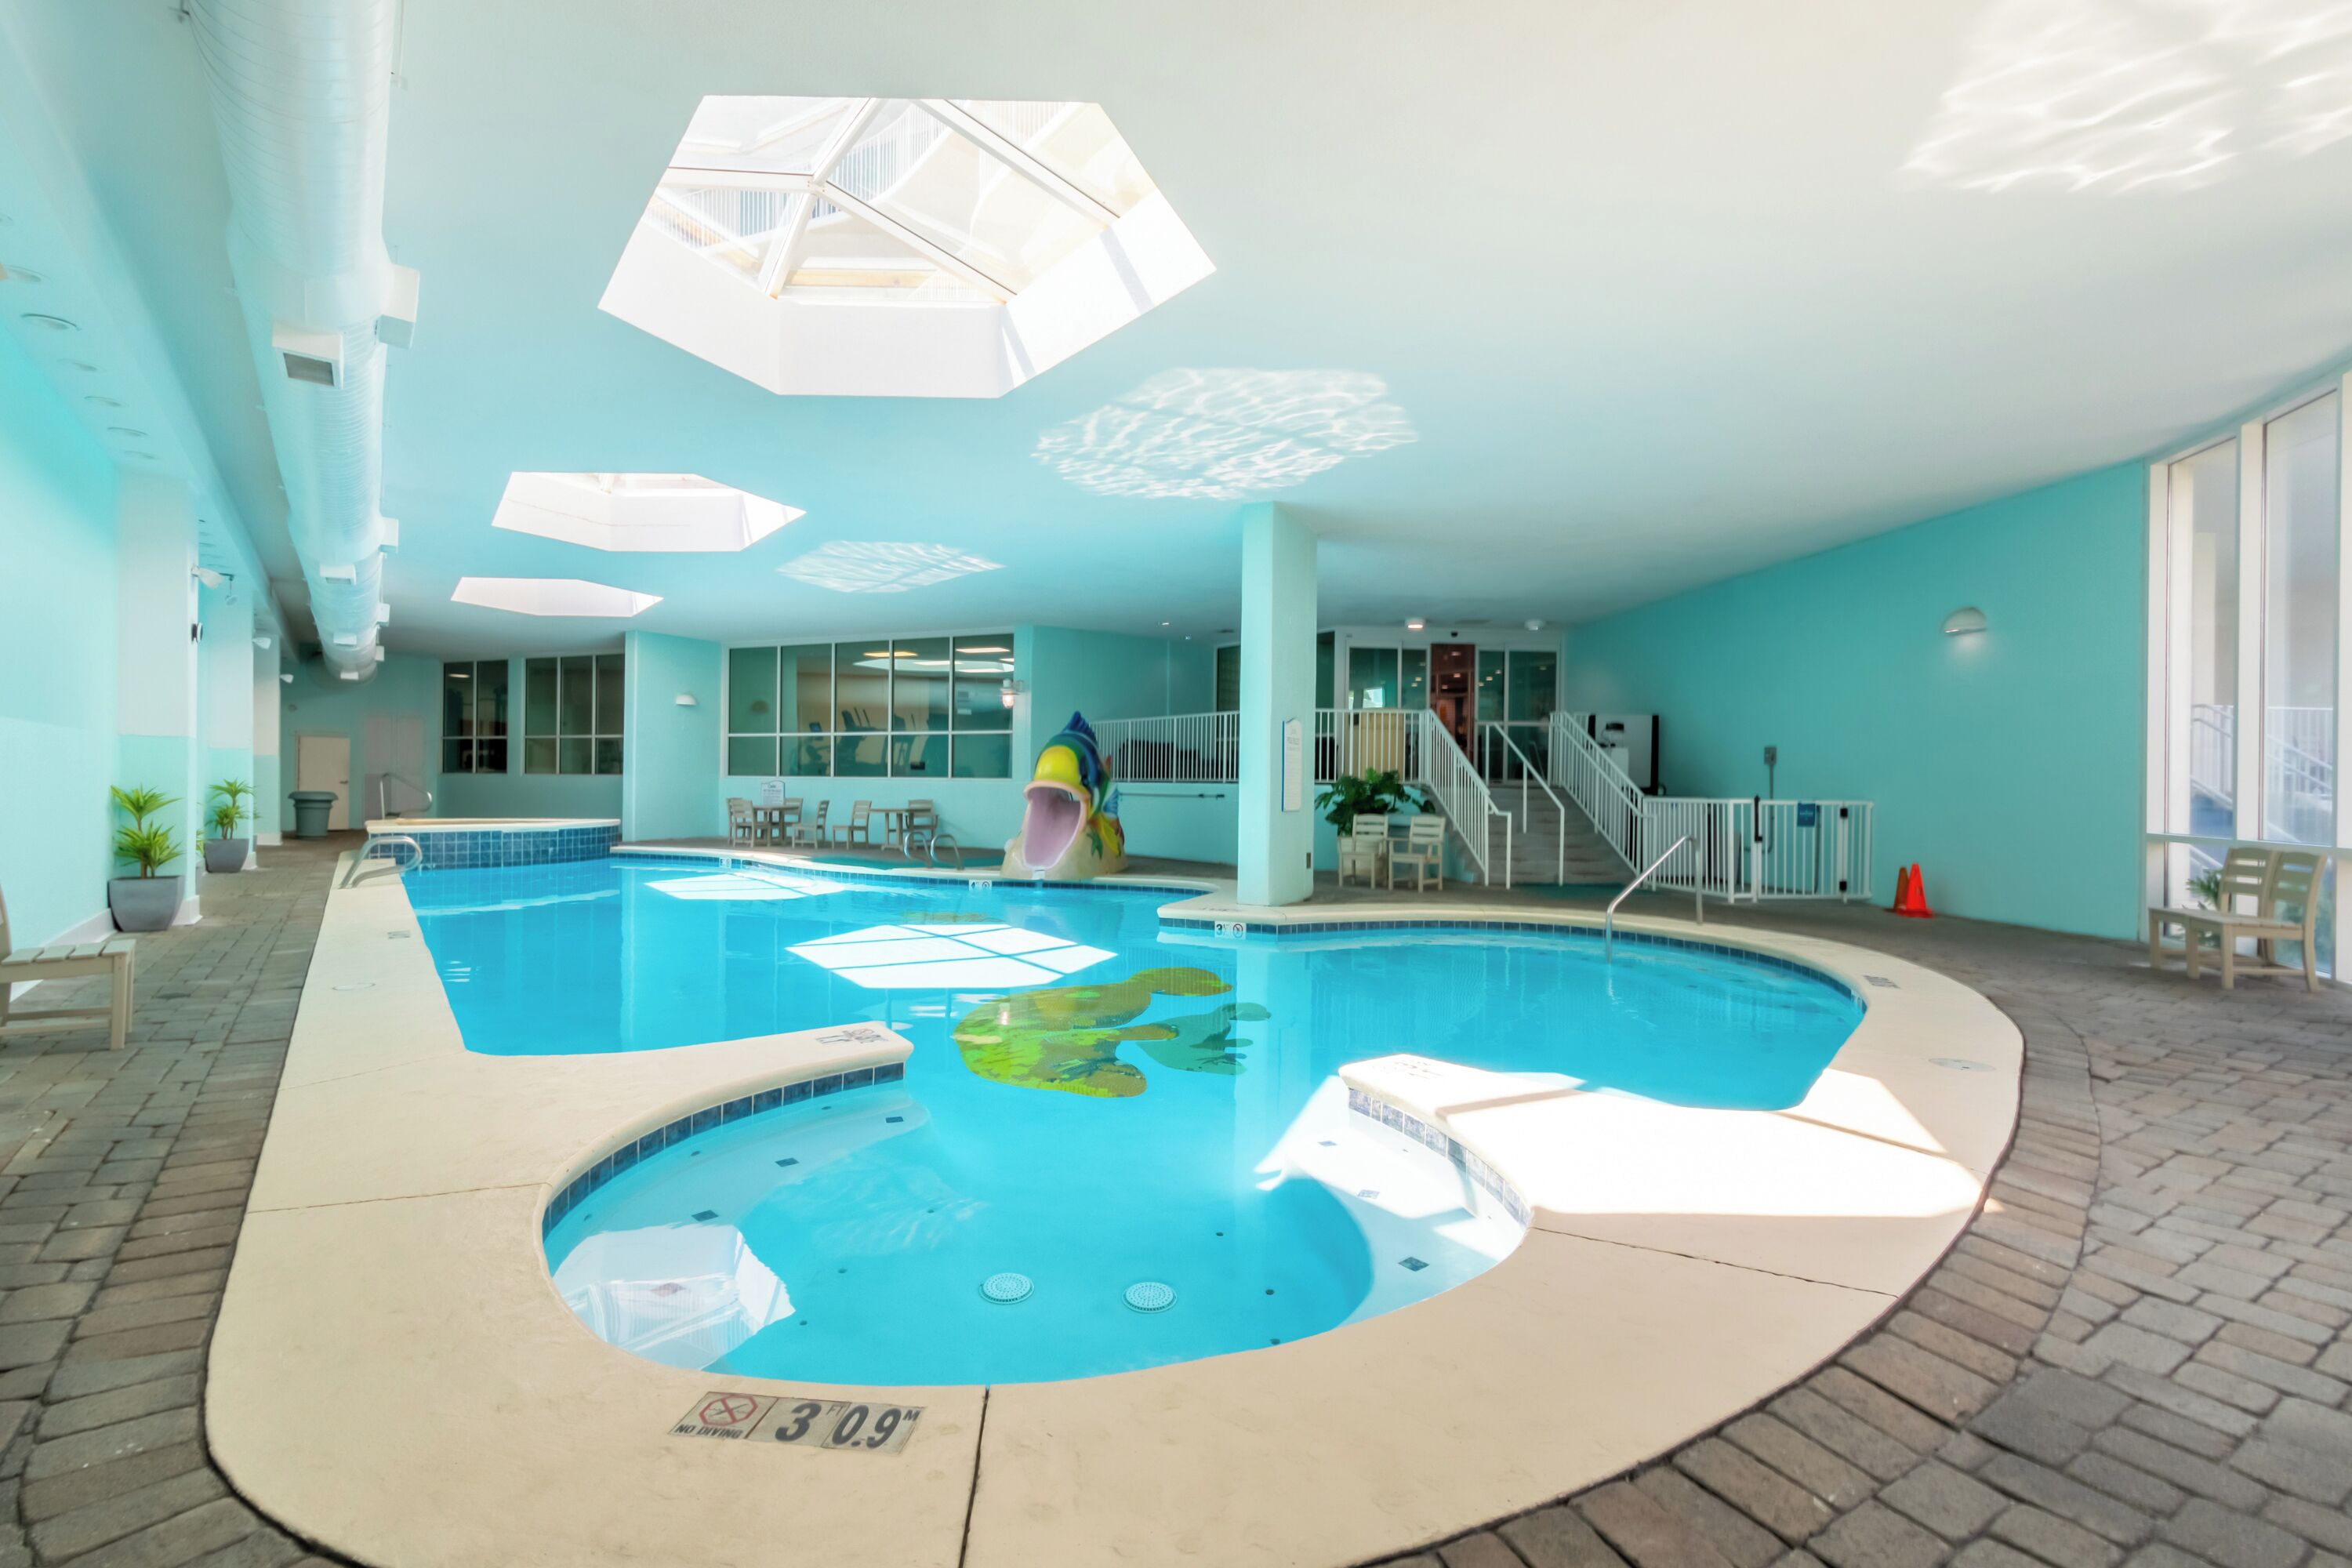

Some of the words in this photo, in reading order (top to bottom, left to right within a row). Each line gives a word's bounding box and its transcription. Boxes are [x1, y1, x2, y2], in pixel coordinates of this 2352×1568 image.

[826, 1404, 848, 1417] FT
[902, 1410, 920, 1421] M
[775, 1403, 822, 1442] 3
[832, 1405, 902, 1448] 0.9
[674, 1424, 696, 1433] NO
[696, 1427, 743, 1439] DIVING
